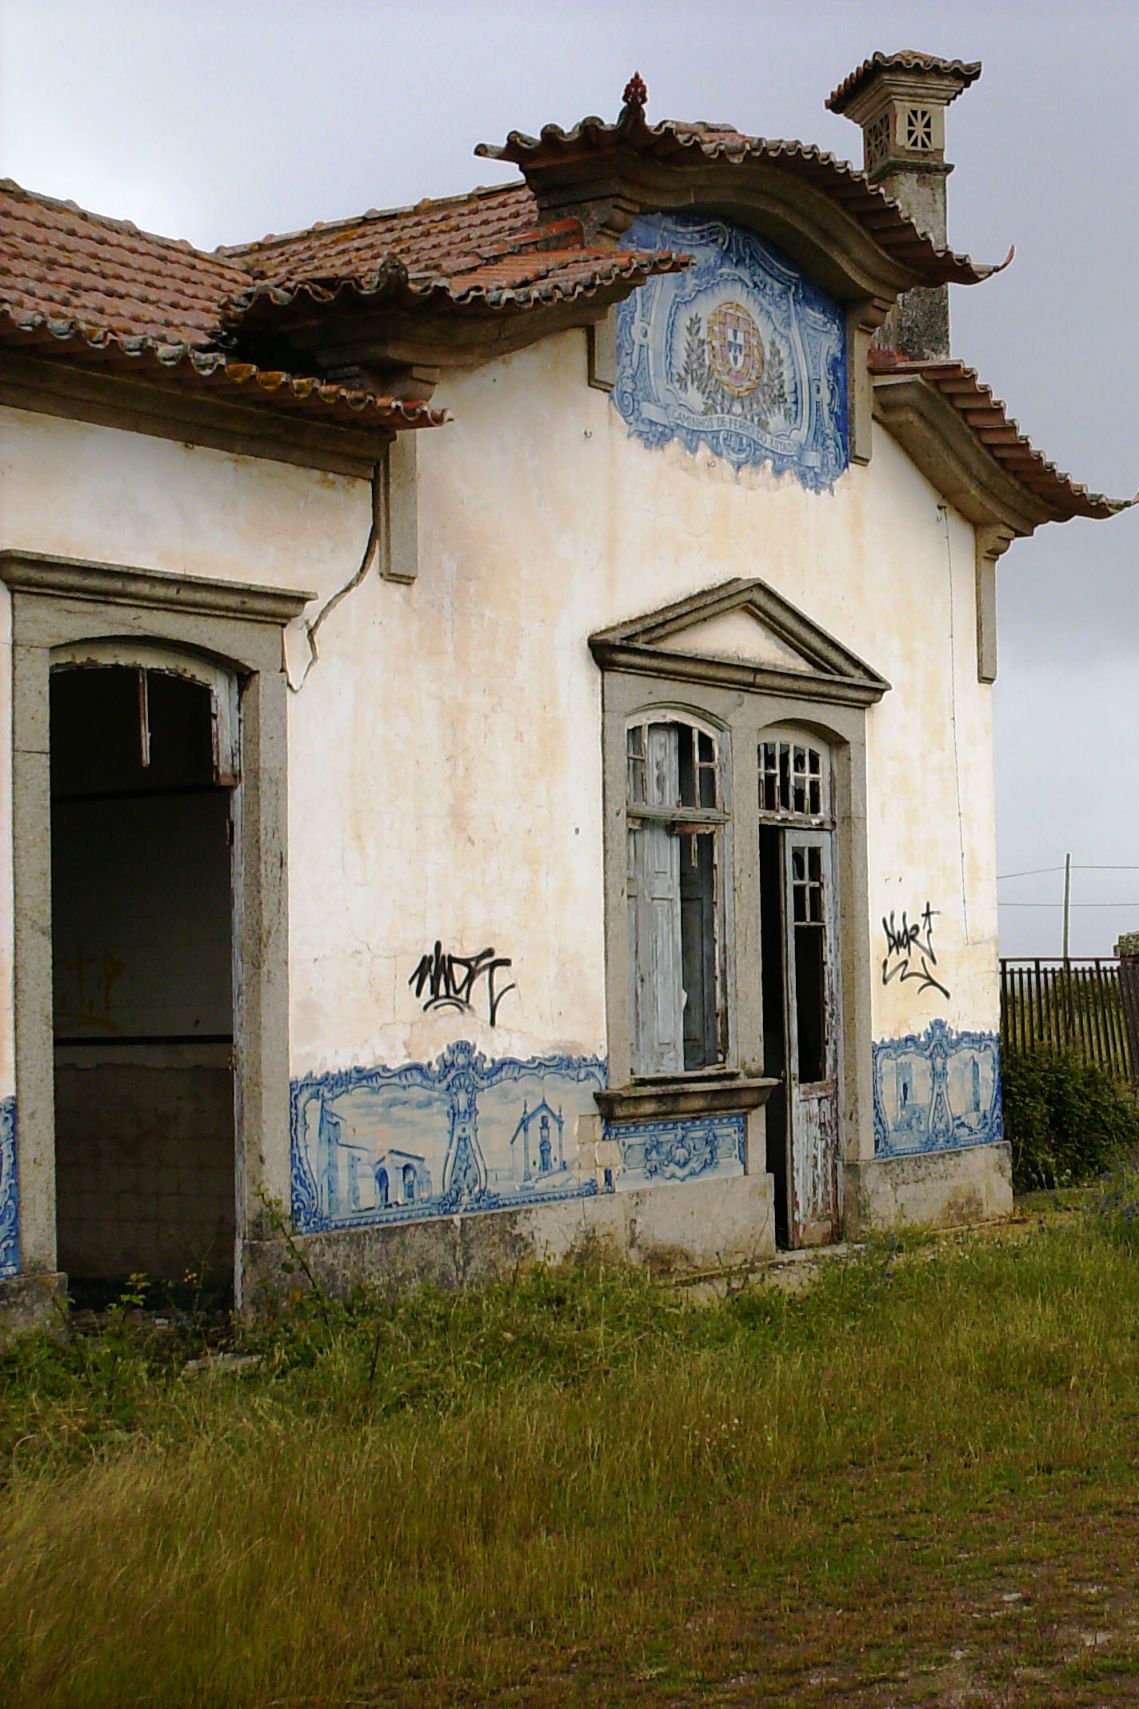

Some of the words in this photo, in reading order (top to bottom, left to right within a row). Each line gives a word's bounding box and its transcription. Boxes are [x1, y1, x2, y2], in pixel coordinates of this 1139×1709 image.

[672, 409, 715, 430] CAMINHOS
[717, 417, 726, 429] DE
[756, 430, 768, 444] DO
[769, 435, 798, 453] ESTADO
